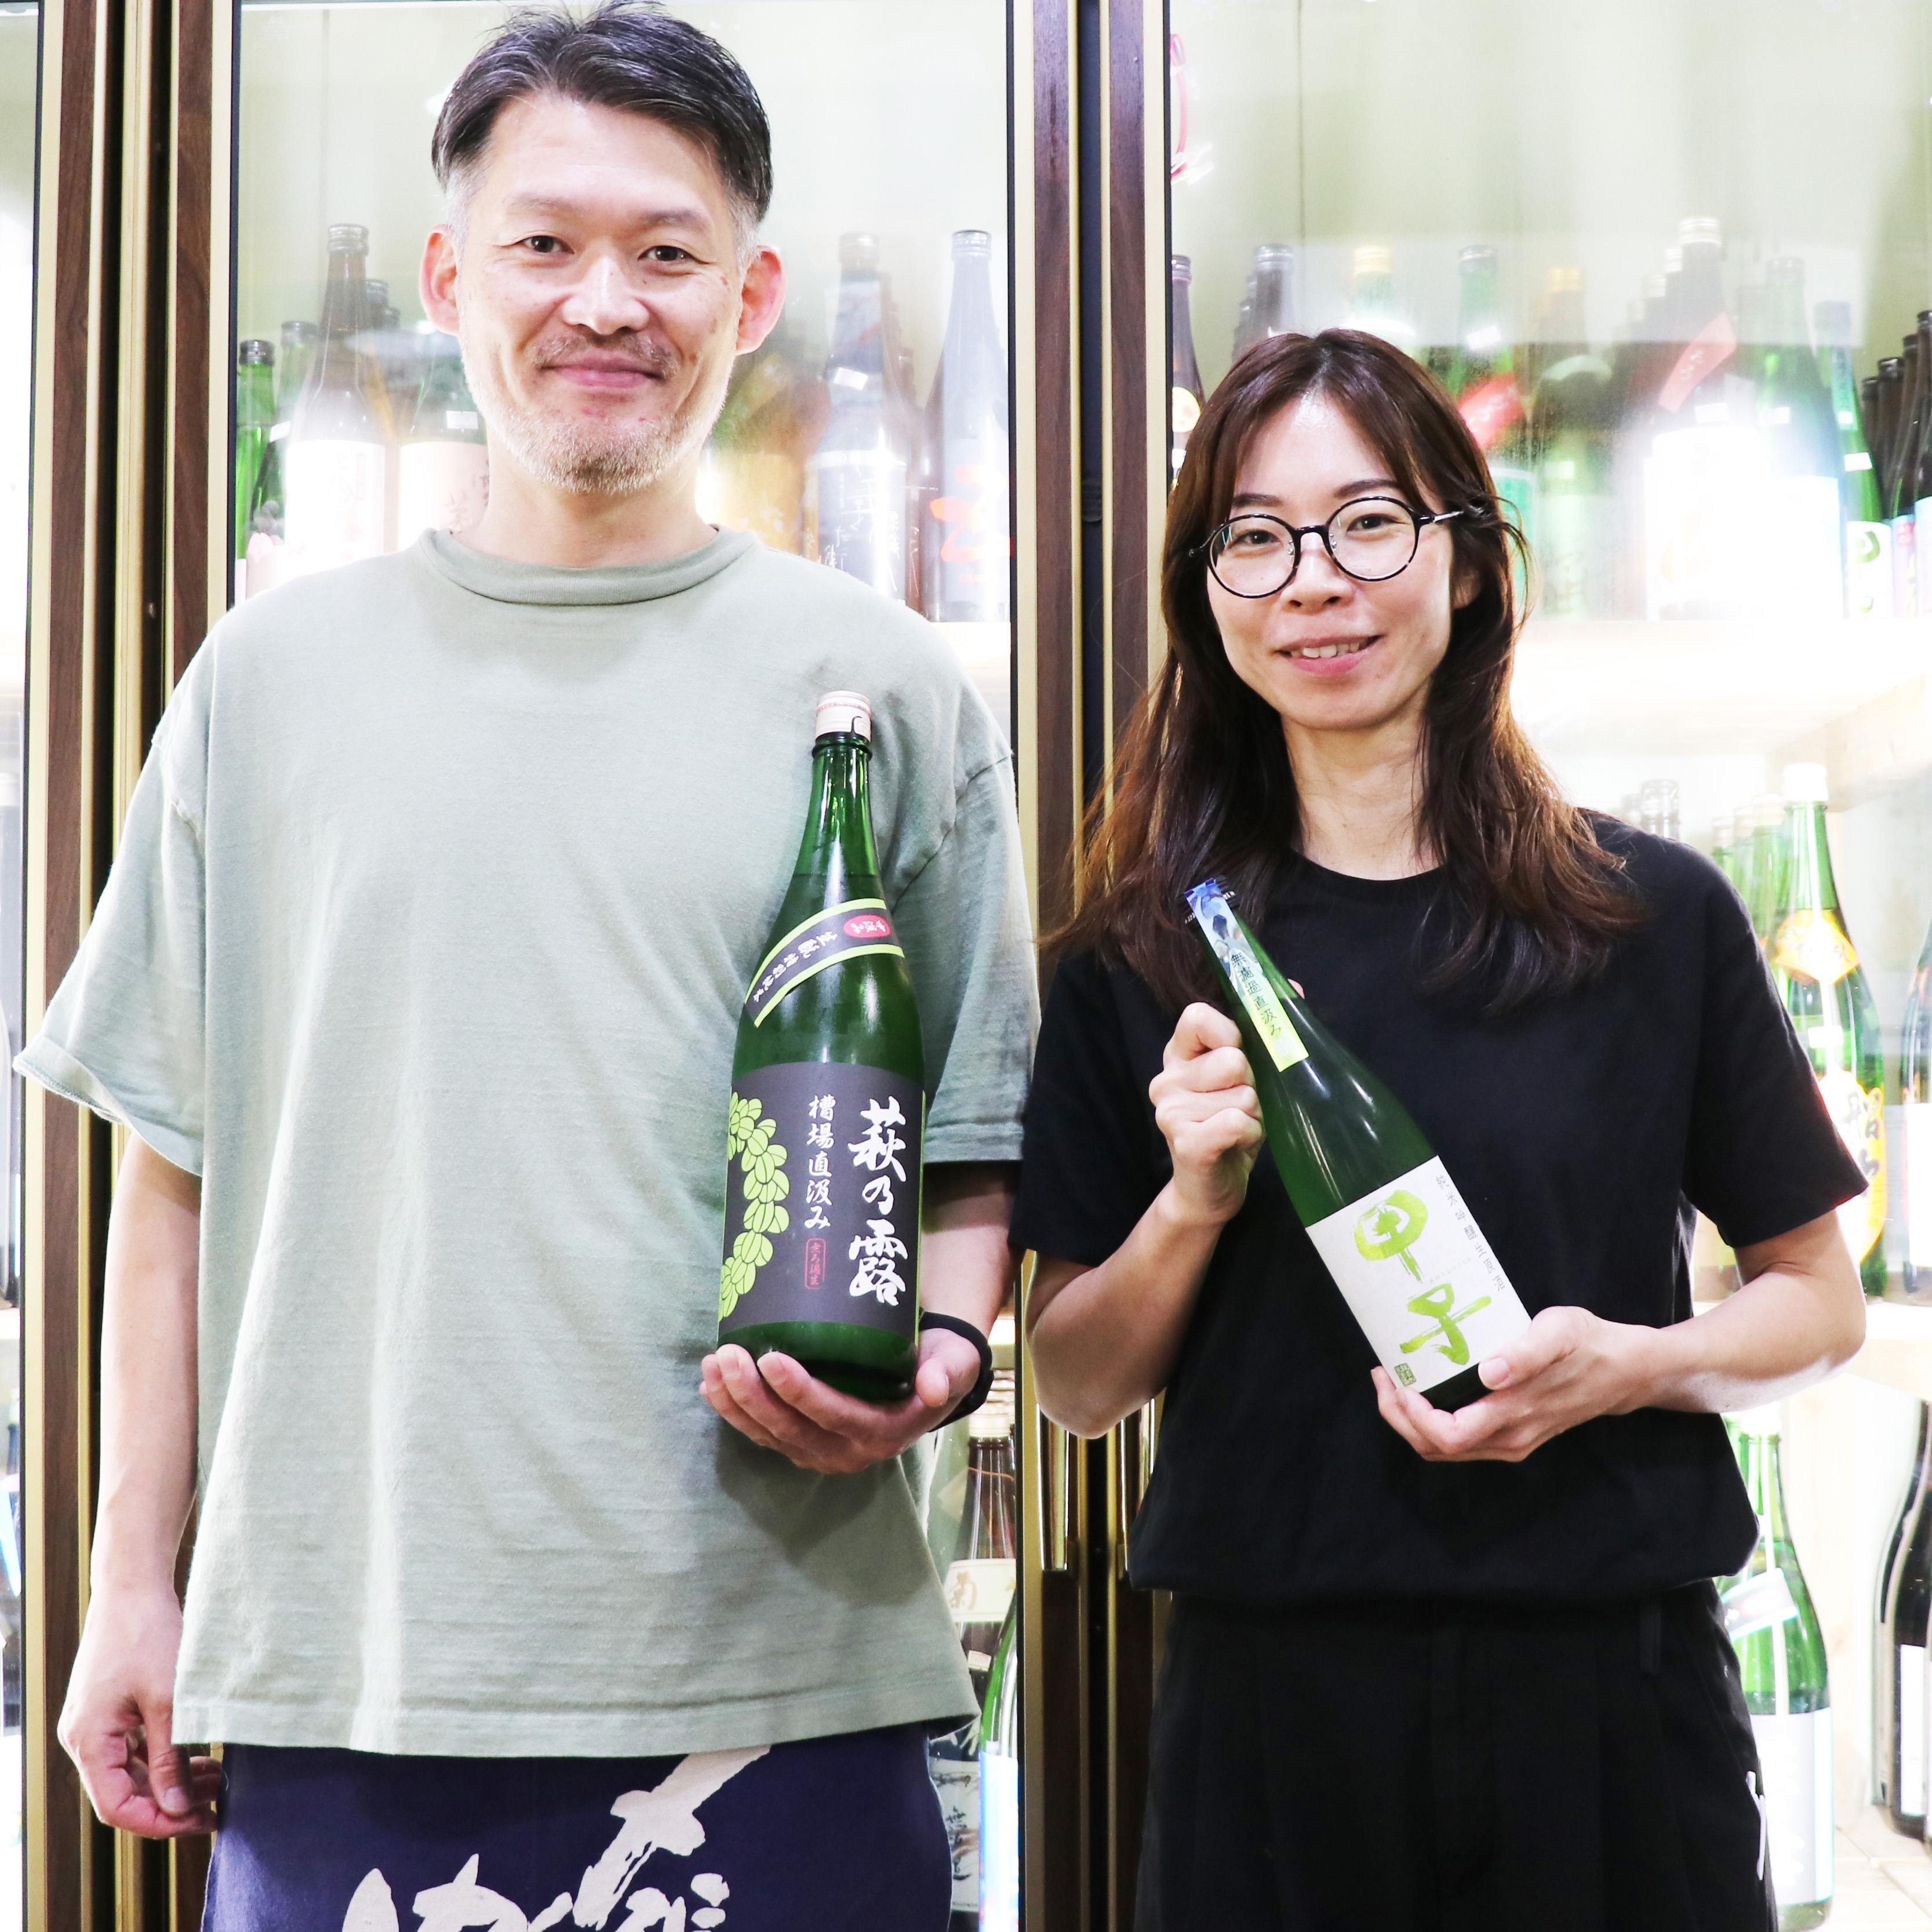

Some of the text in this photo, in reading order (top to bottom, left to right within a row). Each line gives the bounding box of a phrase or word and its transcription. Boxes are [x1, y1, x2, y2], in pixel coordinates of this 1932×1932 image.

[804, 1094, 836, 1229] 槽場直汲み
[847, 1096, 908, 1307] 萩乃露
